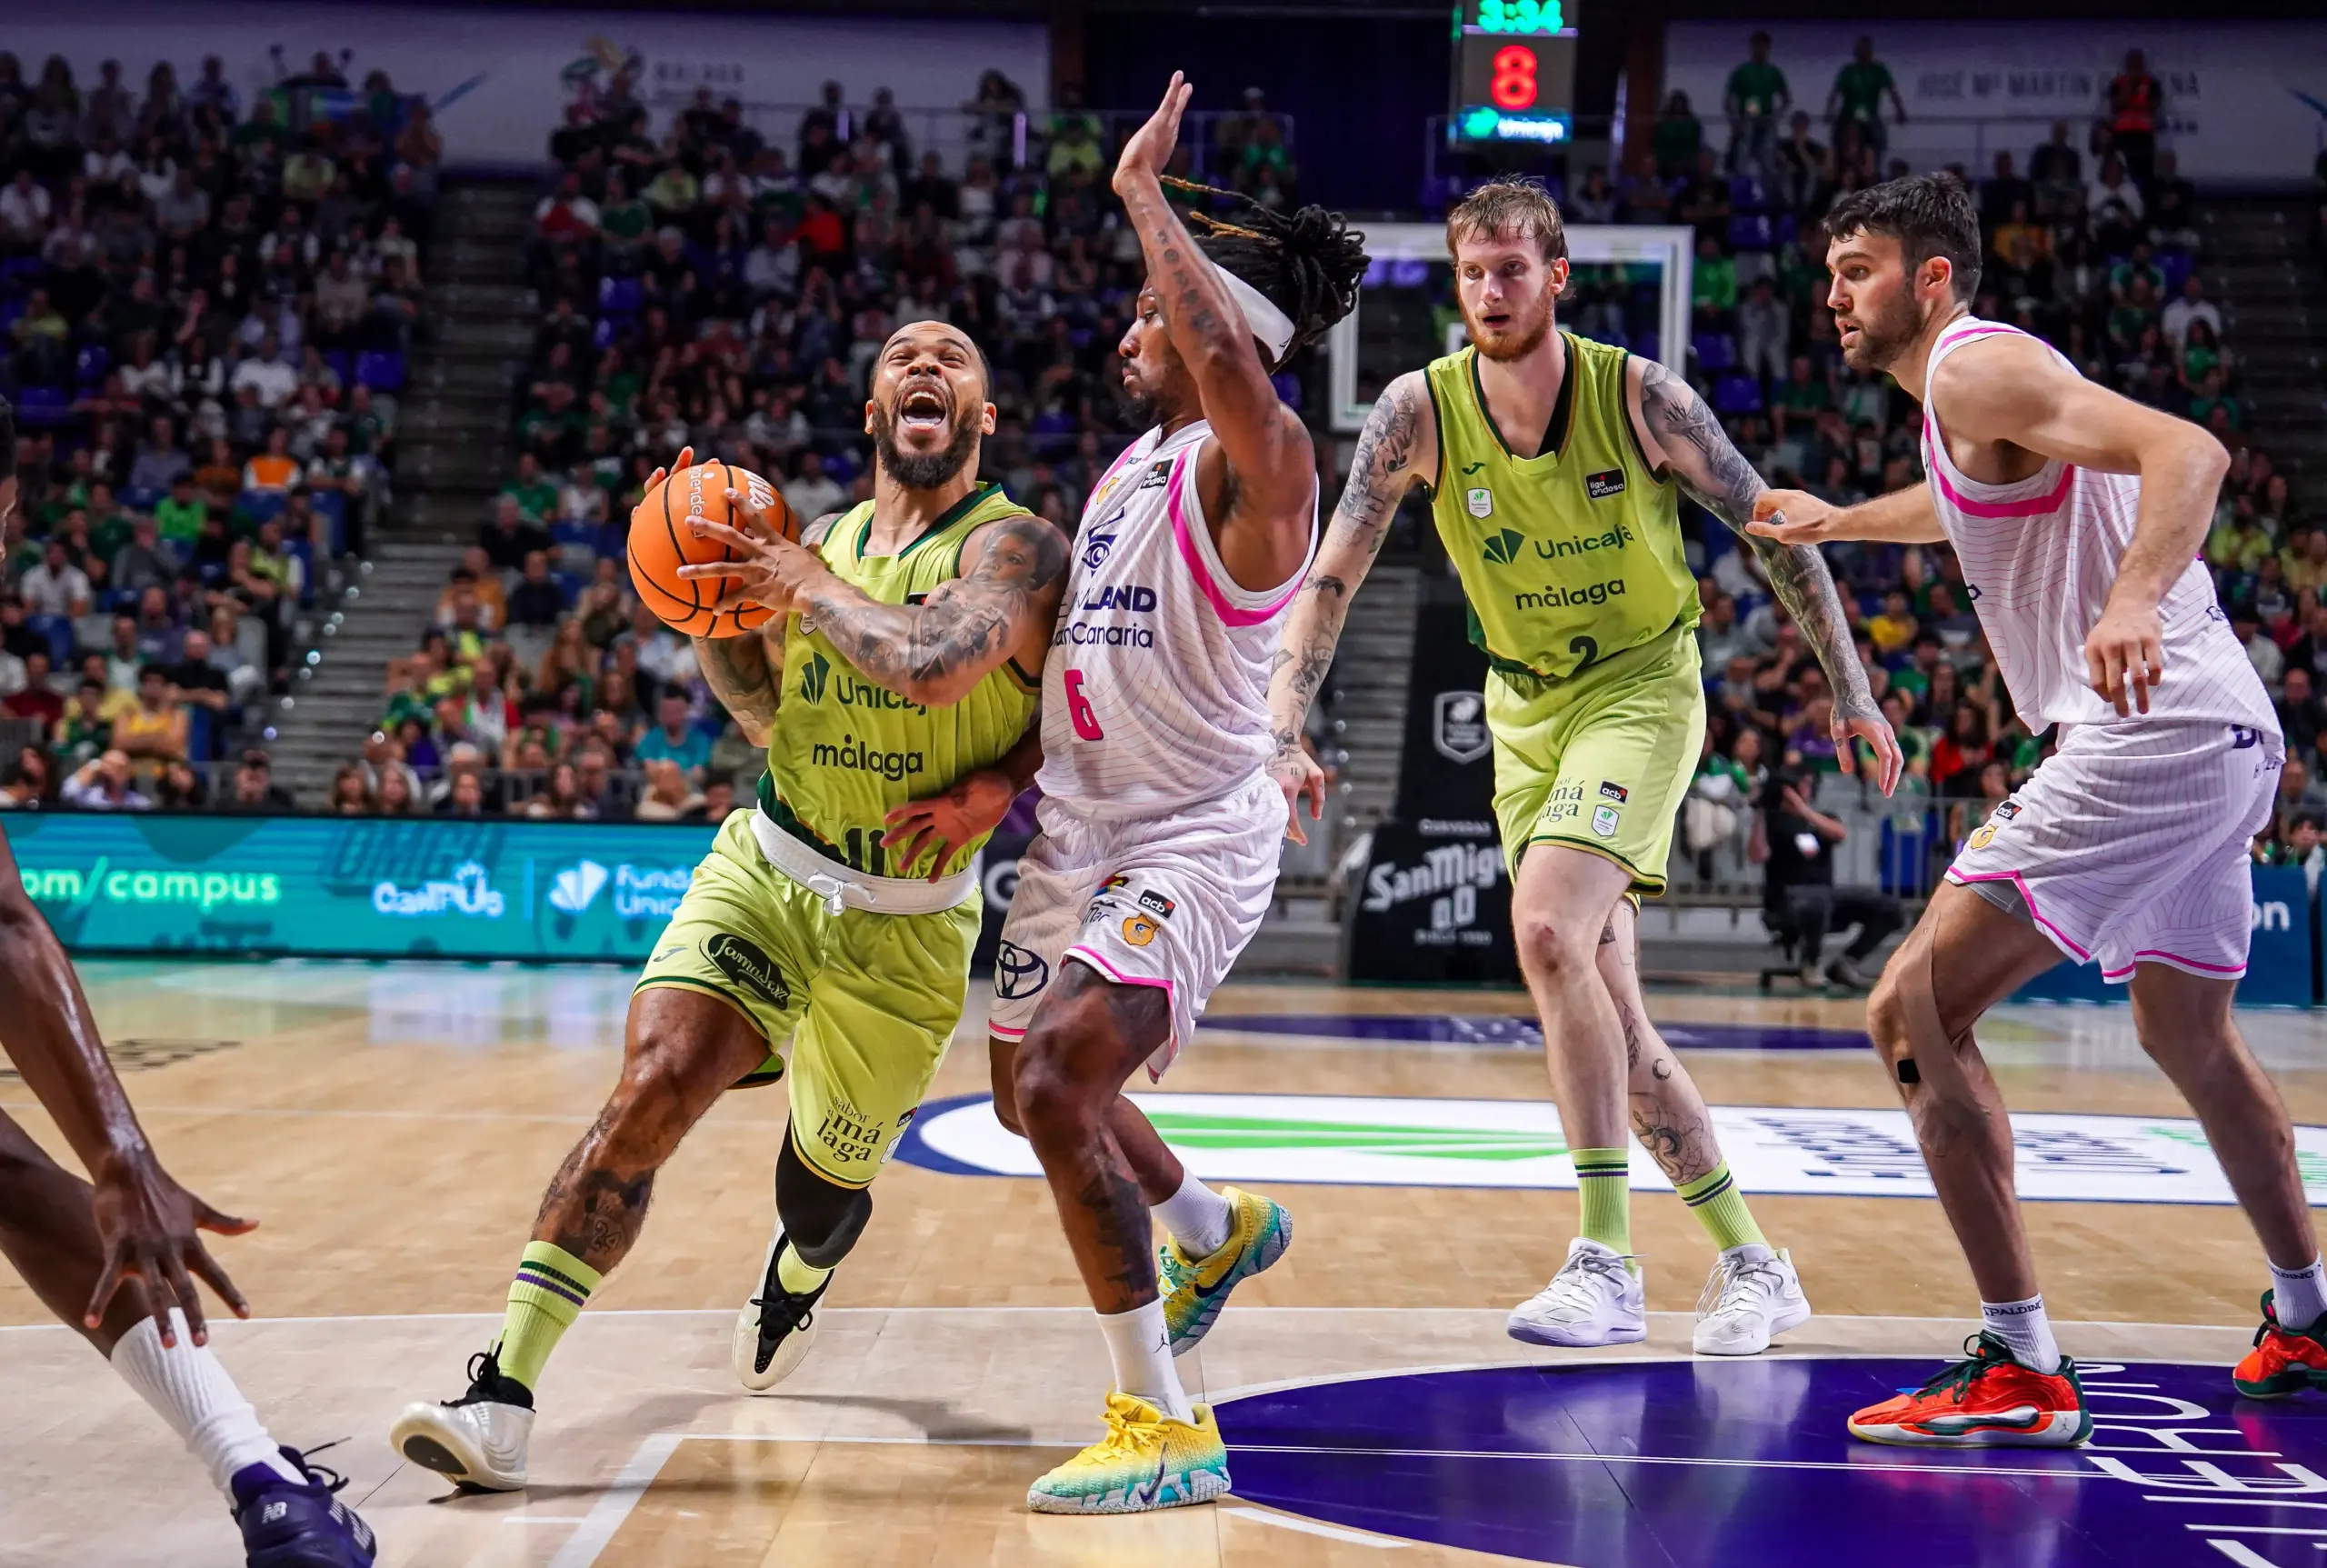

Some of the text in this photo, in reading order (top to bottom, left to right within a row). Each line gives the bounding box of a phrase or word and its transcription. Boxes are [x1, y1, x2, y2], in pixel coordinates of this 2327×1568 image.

[1491, 45, 1537, 110] 8
[1590, 481, 1605, 489] liga
[1592, 484, 1624, 495] endesa
[1569, 635, 1598, 676] 2
[1064, 669, 1104, 741] 6
[1602, 787, 1622, 800] acb
[1142, 896, 1165, 913] acb
[833, 1096, 871, 1124] sabor
[816, 1116, 872, 1163] laga
